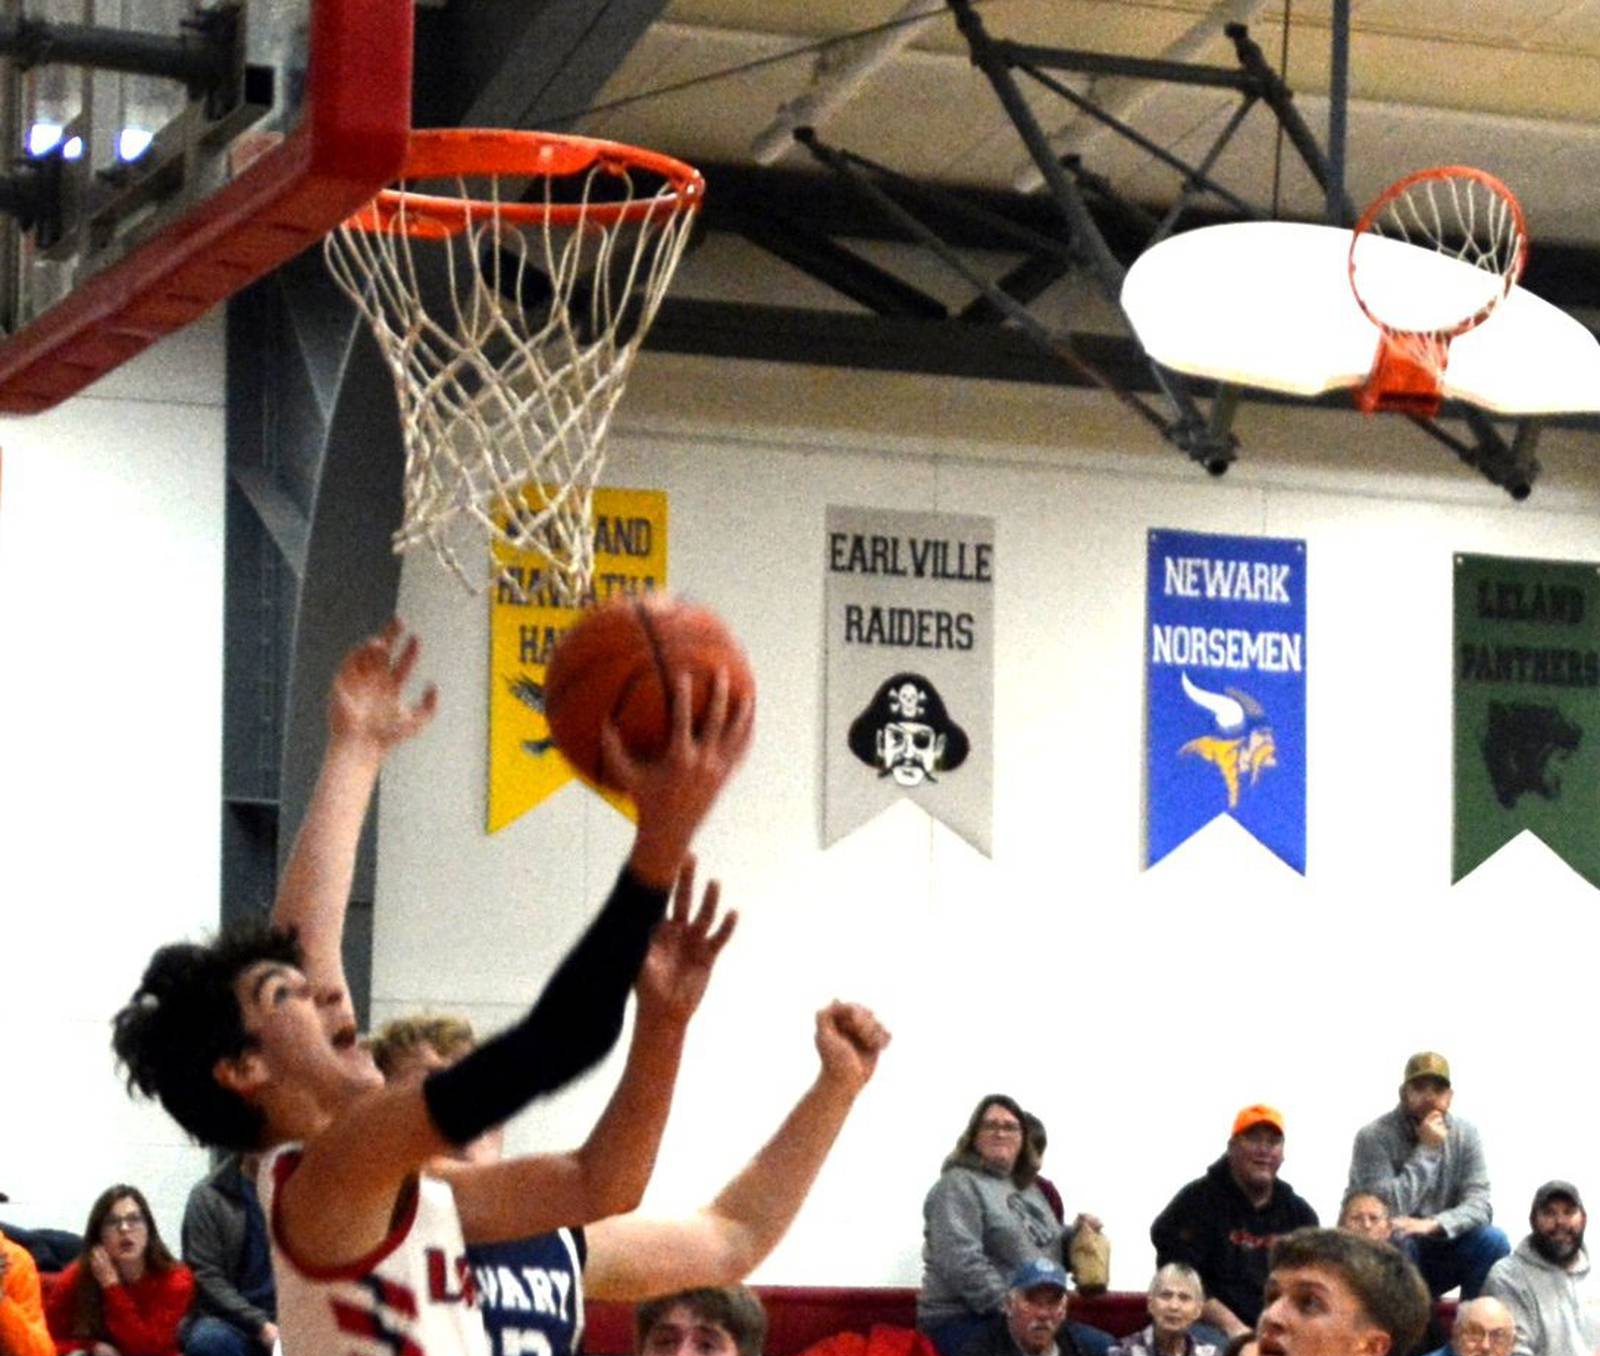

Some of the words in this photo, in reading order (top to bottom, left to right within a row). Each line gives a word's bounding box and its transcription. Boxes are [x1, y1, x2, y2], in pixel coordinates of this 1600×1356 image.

[829, 532, 992, 583] EARLVILLE
[1164, 556, 1291, 604] NEWARK
[844, 605, 975, 651] RAIDERS
[1152, 624, 1302, 672] NORSEMEN
